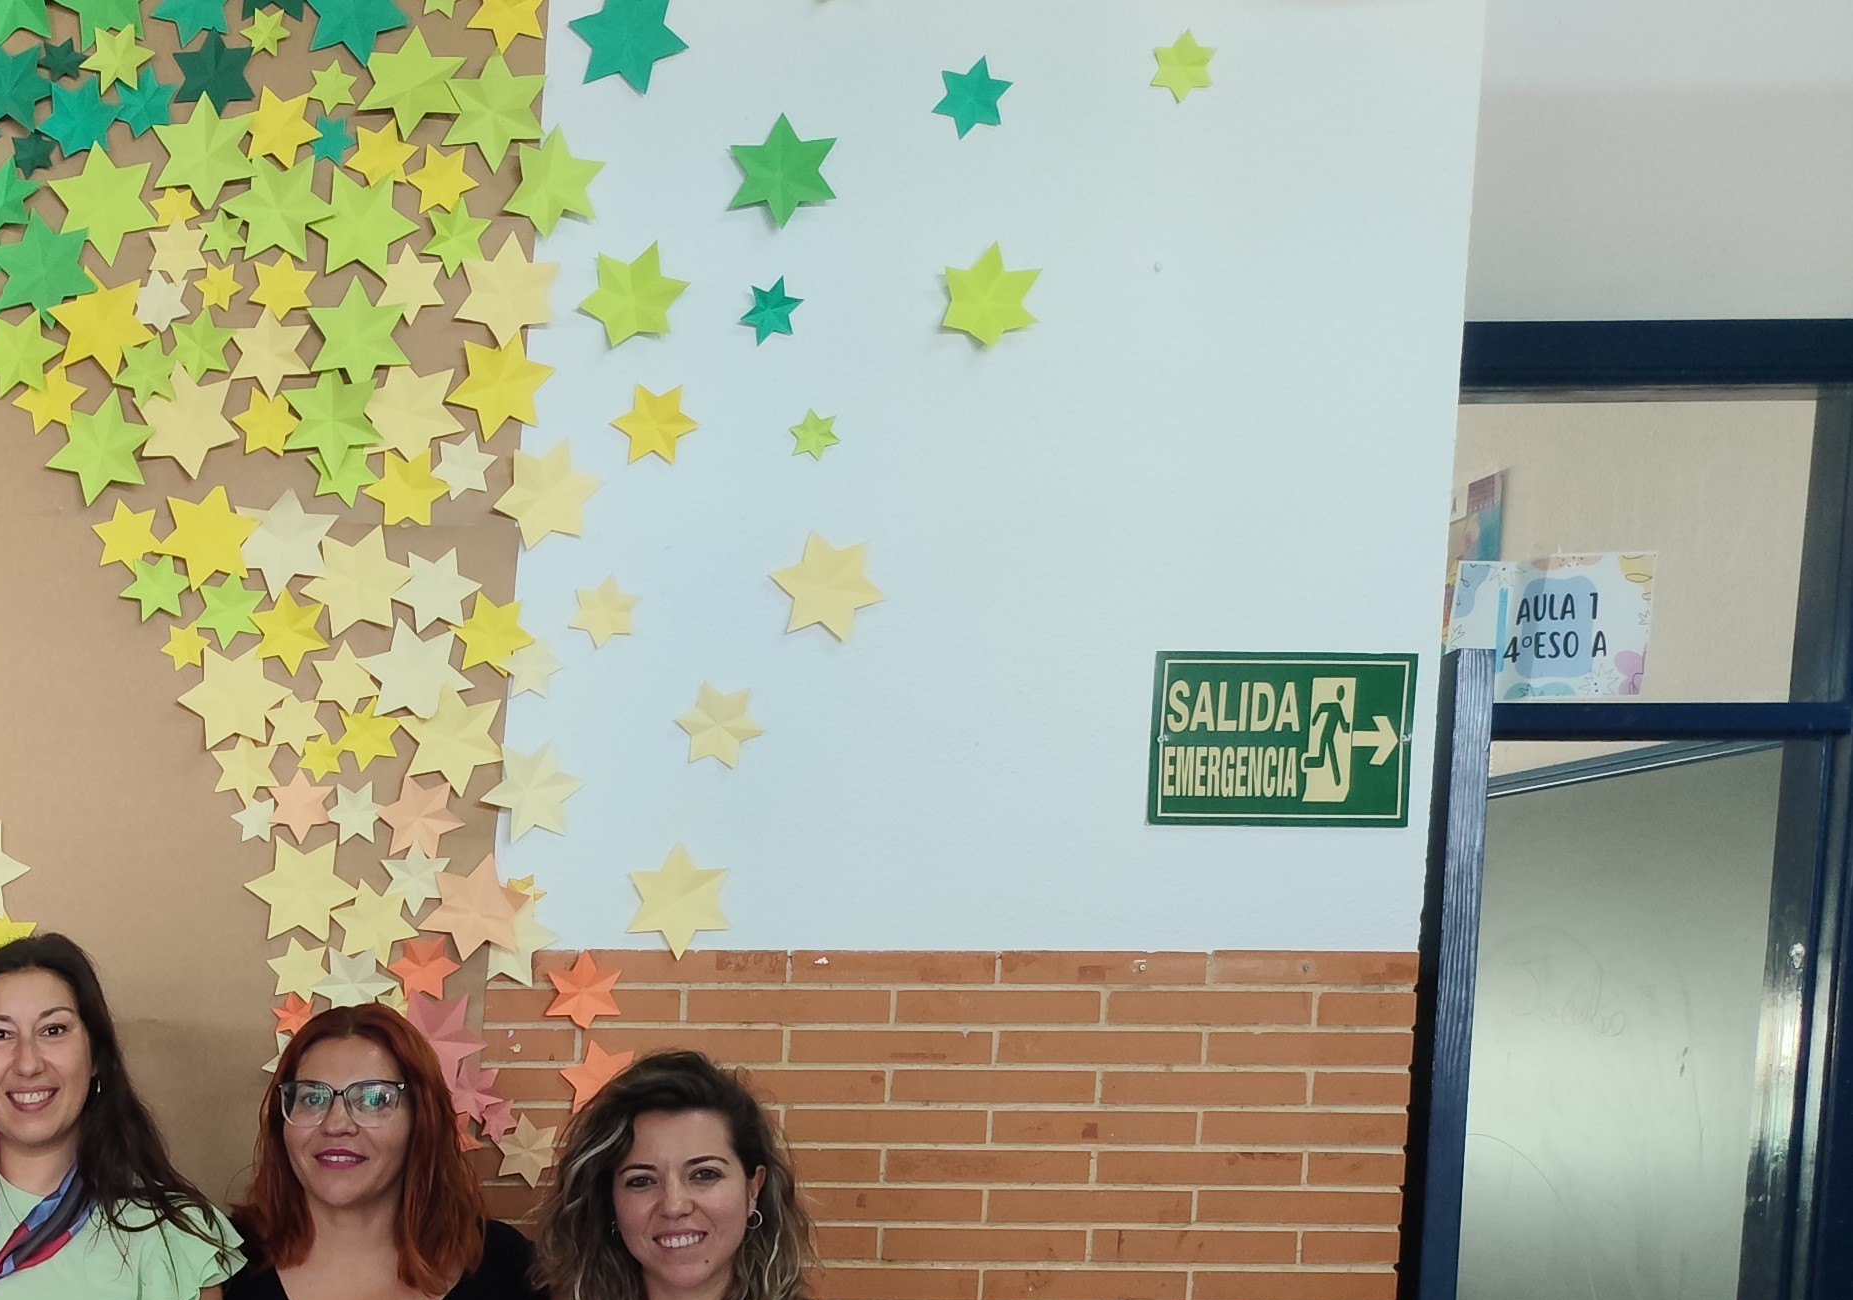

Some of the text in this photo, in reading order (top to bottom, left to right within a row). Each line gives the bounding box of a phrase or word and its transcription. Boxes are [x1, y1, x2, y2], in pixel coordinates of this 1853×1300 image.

[1515, 592, 1598, 625] AULA 1
[1591, 630, 1607, 658] A
[1167, 680, 1300, 732] SALIDA
[1163, 746, 1297, 798] EMERGENCIA
